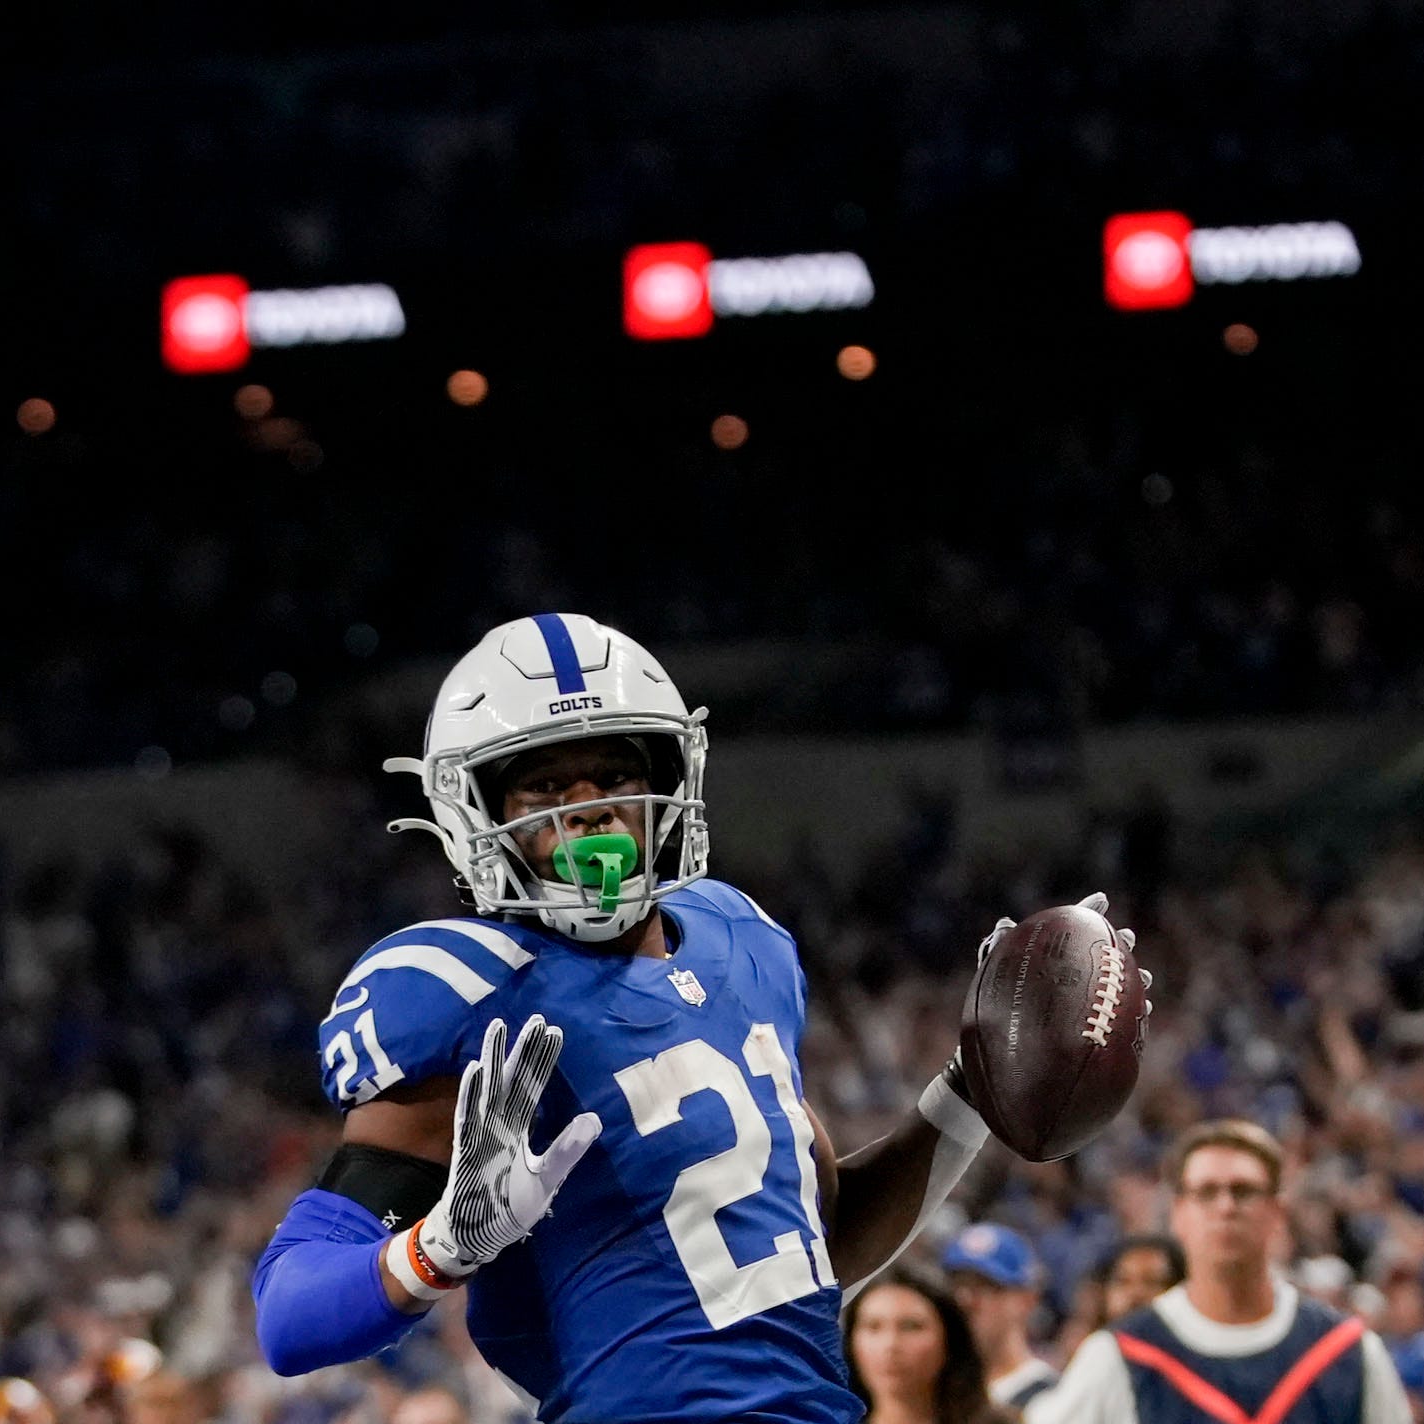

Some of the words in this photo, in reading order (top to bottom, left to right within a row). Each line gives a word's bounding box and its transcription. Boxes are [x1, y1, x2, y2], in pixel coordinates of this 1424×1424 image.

[549, 696, 603, 715] COLTS
[1013, 955, 1032, 1007] FOOTBALL
[325, 1008, 406, 1106] 21
[613, 1023, 838, 1331] 21
